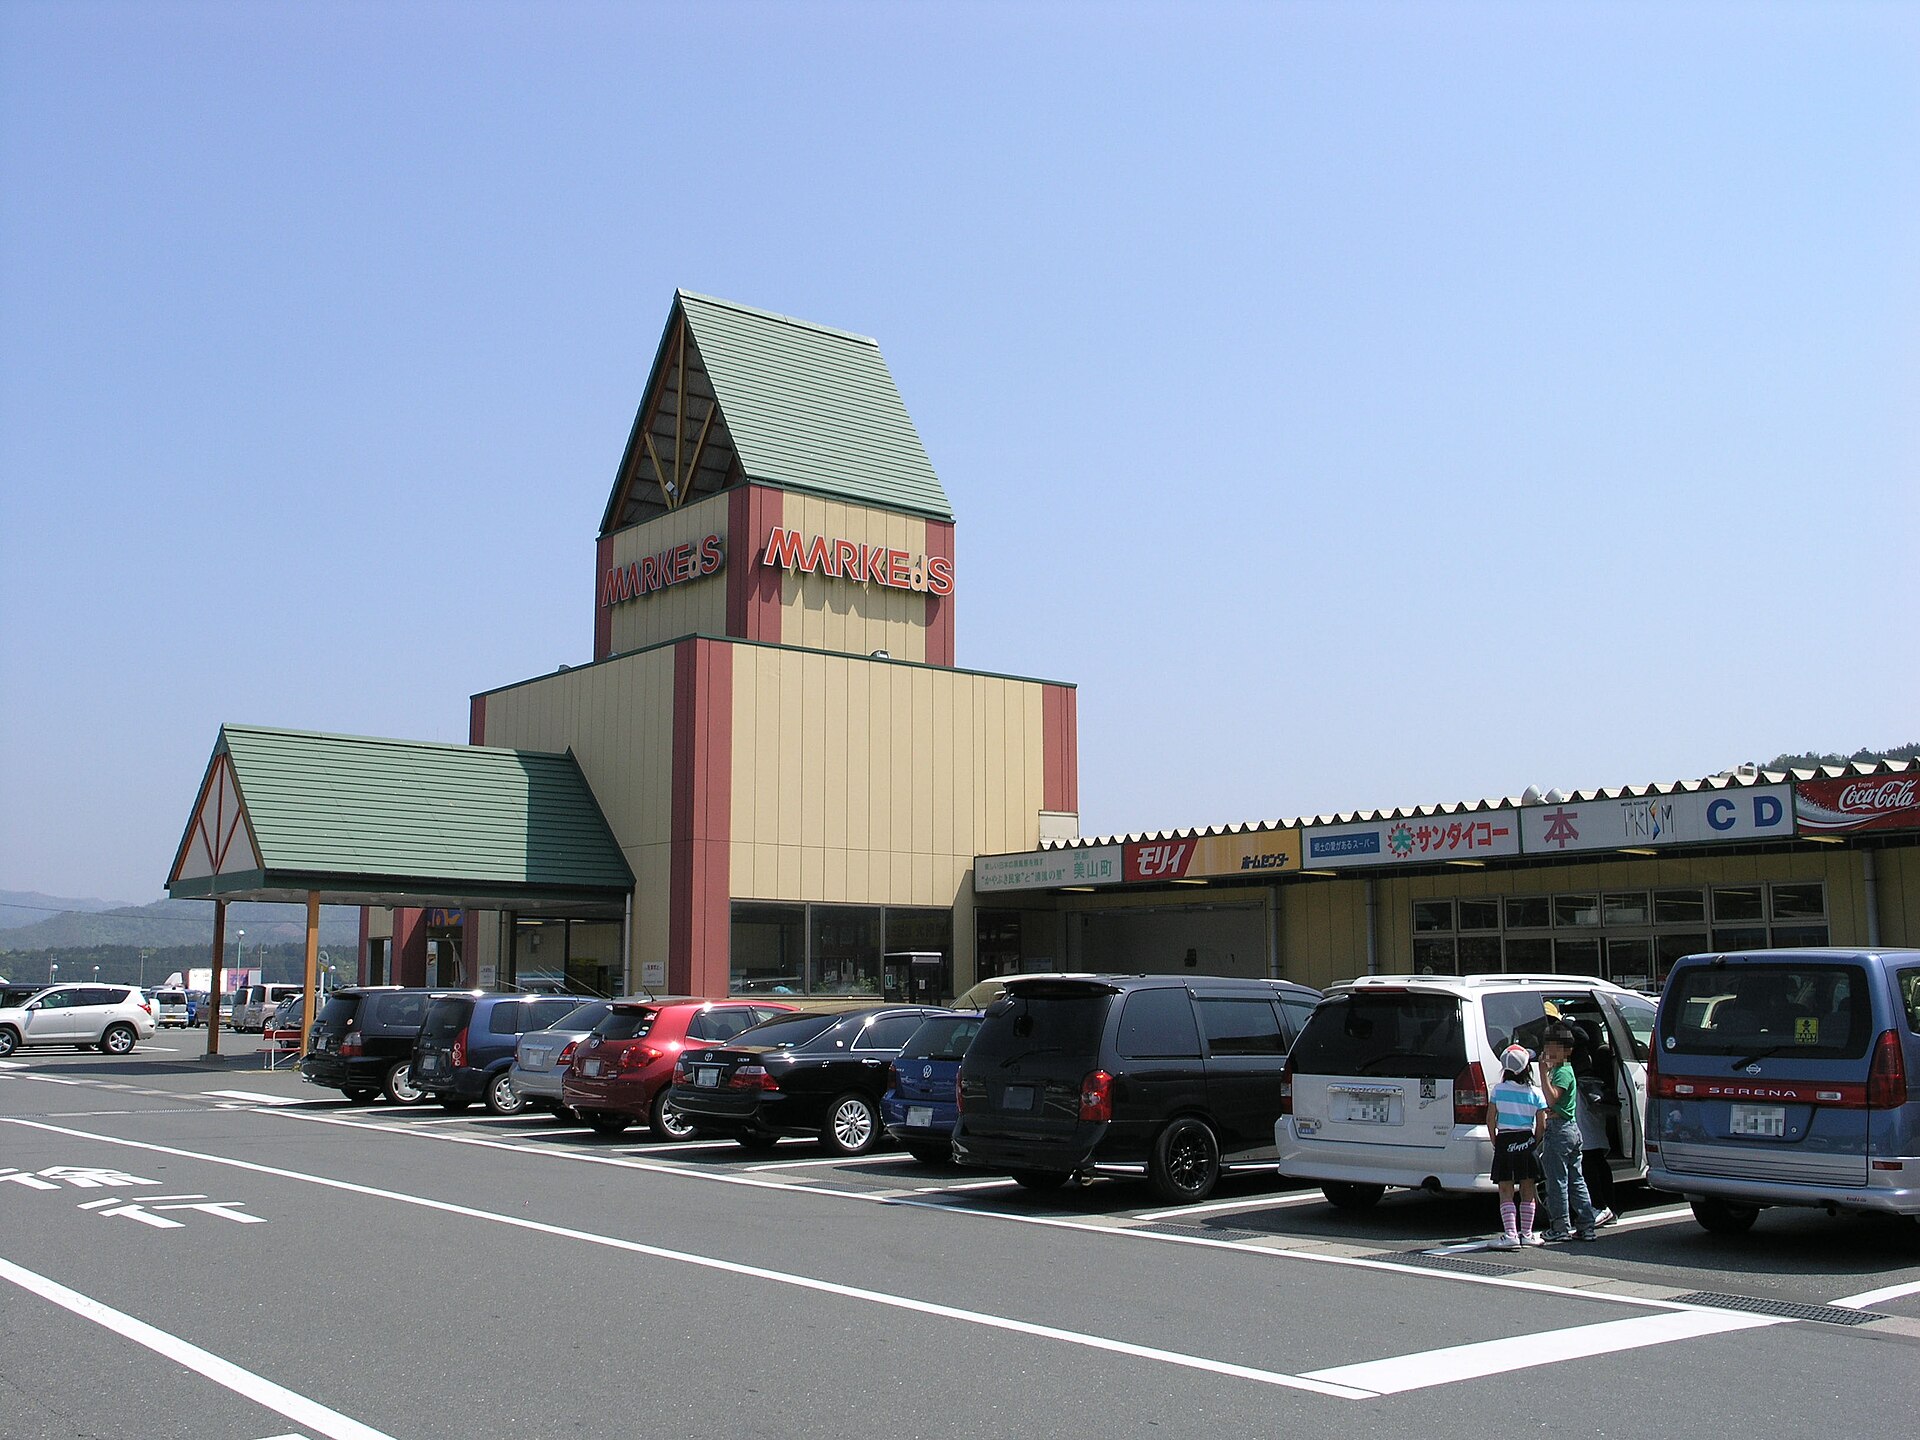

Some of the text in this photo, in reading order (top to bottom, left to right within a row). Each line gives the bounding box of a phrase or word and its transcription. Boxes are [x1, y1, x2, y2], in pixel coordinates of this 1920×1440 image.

[1838, 779, 1918, 811] Coca-Cola
[1416, 822, 1509, 852] サンダイコー
[1543, 807, 1579, 848] 本
[1074, 860, 1112, 879] 美山町
[1136, 844, 1186, 876] モリイ
[1241, 852, 1289, 870] ホームセンター
[1709, 1087, 1797, 1098] SERENA
